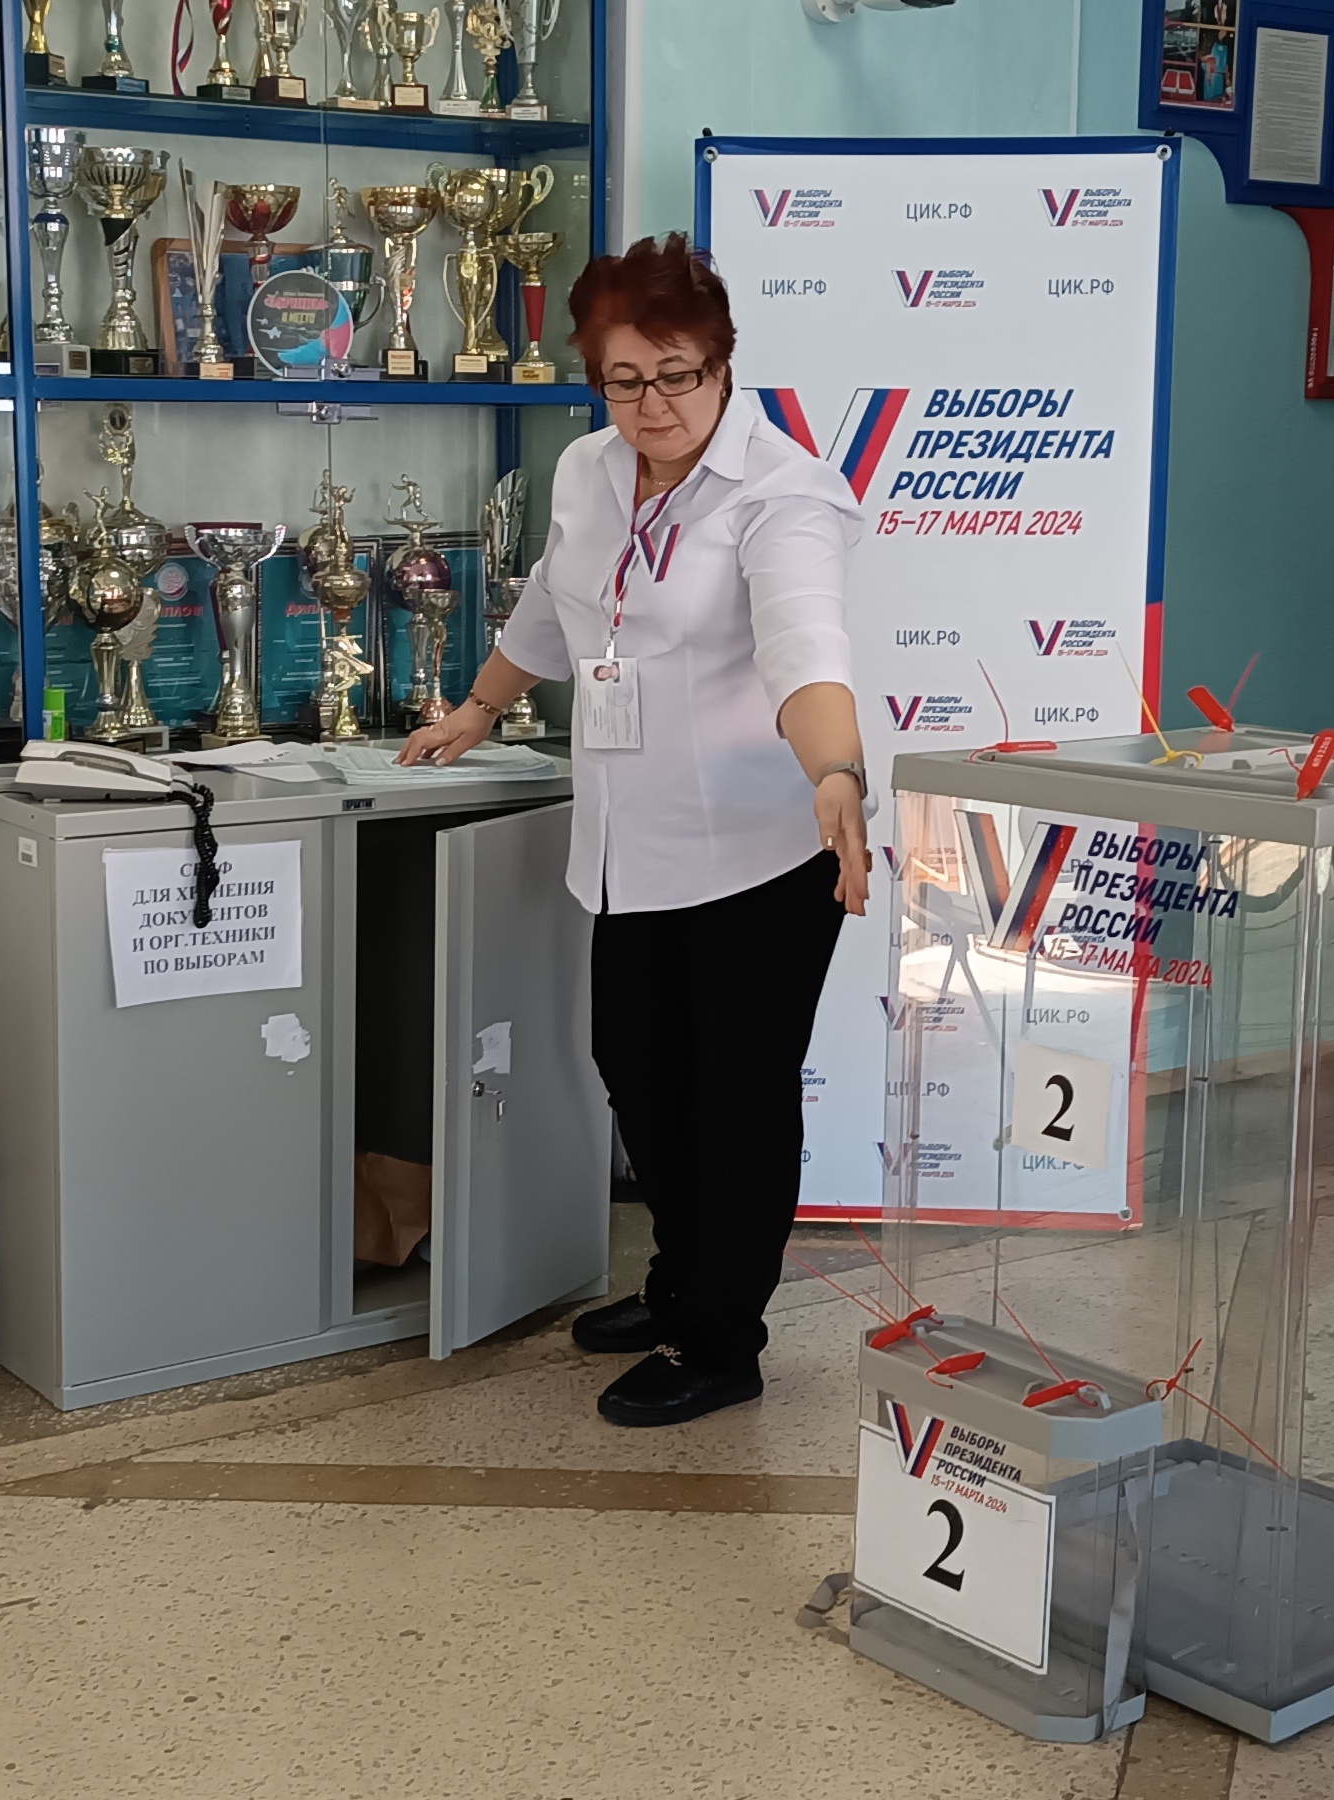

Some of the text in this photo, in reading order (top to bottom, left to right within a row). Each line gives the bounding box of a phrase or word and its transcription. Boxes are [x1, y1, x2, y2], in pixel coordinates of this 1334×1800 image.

[906, 203, 973, 222] ЦИК.РФ
[762, 279, 827, 298] ЦИК.РФ
[1048, 278, 1115, 298] ЦИК.РФ
[923, 388, 1075, 418] ВЫБОРЫ
[906, 429, 1116, 464] ПРЕЗИДЕНТА
[888, 470, 1024, 500] РОССИИ
[941, 510, 1023, 535] МАРТА
[1024, 510, 1083, 535] 2024
[896, 630, 961, 648] ЦИК.РФ
[1034, 707, 1099, 725] ЦИК.РФ
[1087, 830, 1207, 873] ВЫБОРЫ
[132, 880, 275, 907] ДЛЯ ХРНЕНИЯ
[1072, 864, 1241, 919] ПРЕЗИДЕНТА
[139, 904, 269, 930] ДОКУЕНТОВ
[1058, 903, 1163, 945] РОССИИ
[132, 926, 276, 952] И ОРГ.ТЕХНИКИ
[144, 950, 265, 975] ПО ВЫБОРАМ
[1097, 945, 1160, 980] МАРТА
[1162, 960, 1213, 989] 2024
[1026, 1008, 1091, 1025] ЦИК.РФ
[886, 1081, 950, 1098] ЦИ.РФ
[1041, 1074, 1075, 1141] 2
[950, 1425, 1007, 1456] ВЫБОРЫ
[936, 1459, 987, 1488] РОССИИ
[943, 1442, 1023, 1483] ПРЕЗИДЕНТА
[954, 1484, 985, 1506] МАРТА
[984, 1496, 1008, 1514] 2024
[922, 1499, 965, 1592] 2
